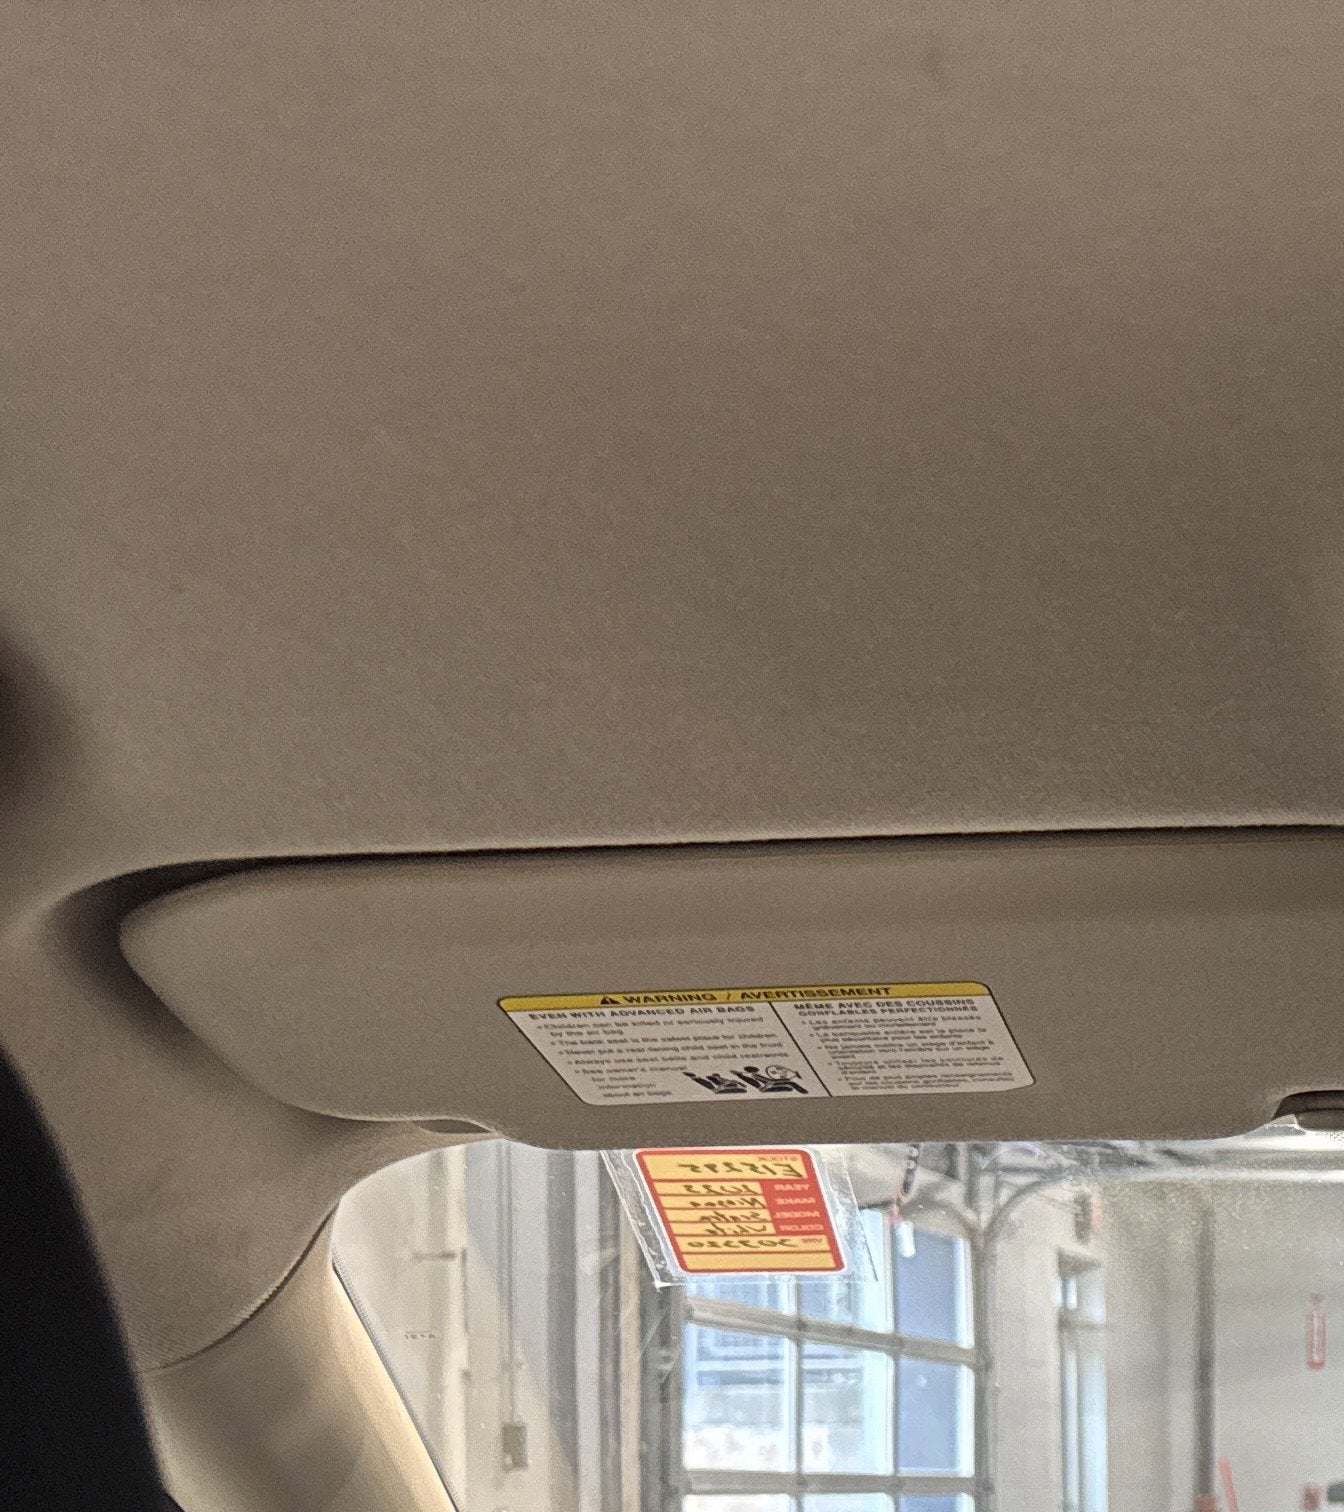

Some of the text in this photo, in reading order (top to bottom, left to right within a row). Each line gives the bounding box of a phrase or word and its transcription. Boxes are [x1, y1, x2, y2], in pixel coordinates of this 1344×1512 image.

[623, 992, 717, 1004] WARNING
[740, 987, 892, 1001] AVERTISSEMENT
[528, 1005, 756, 1020] EVEN WITH ADVANCED AIR BAGS
